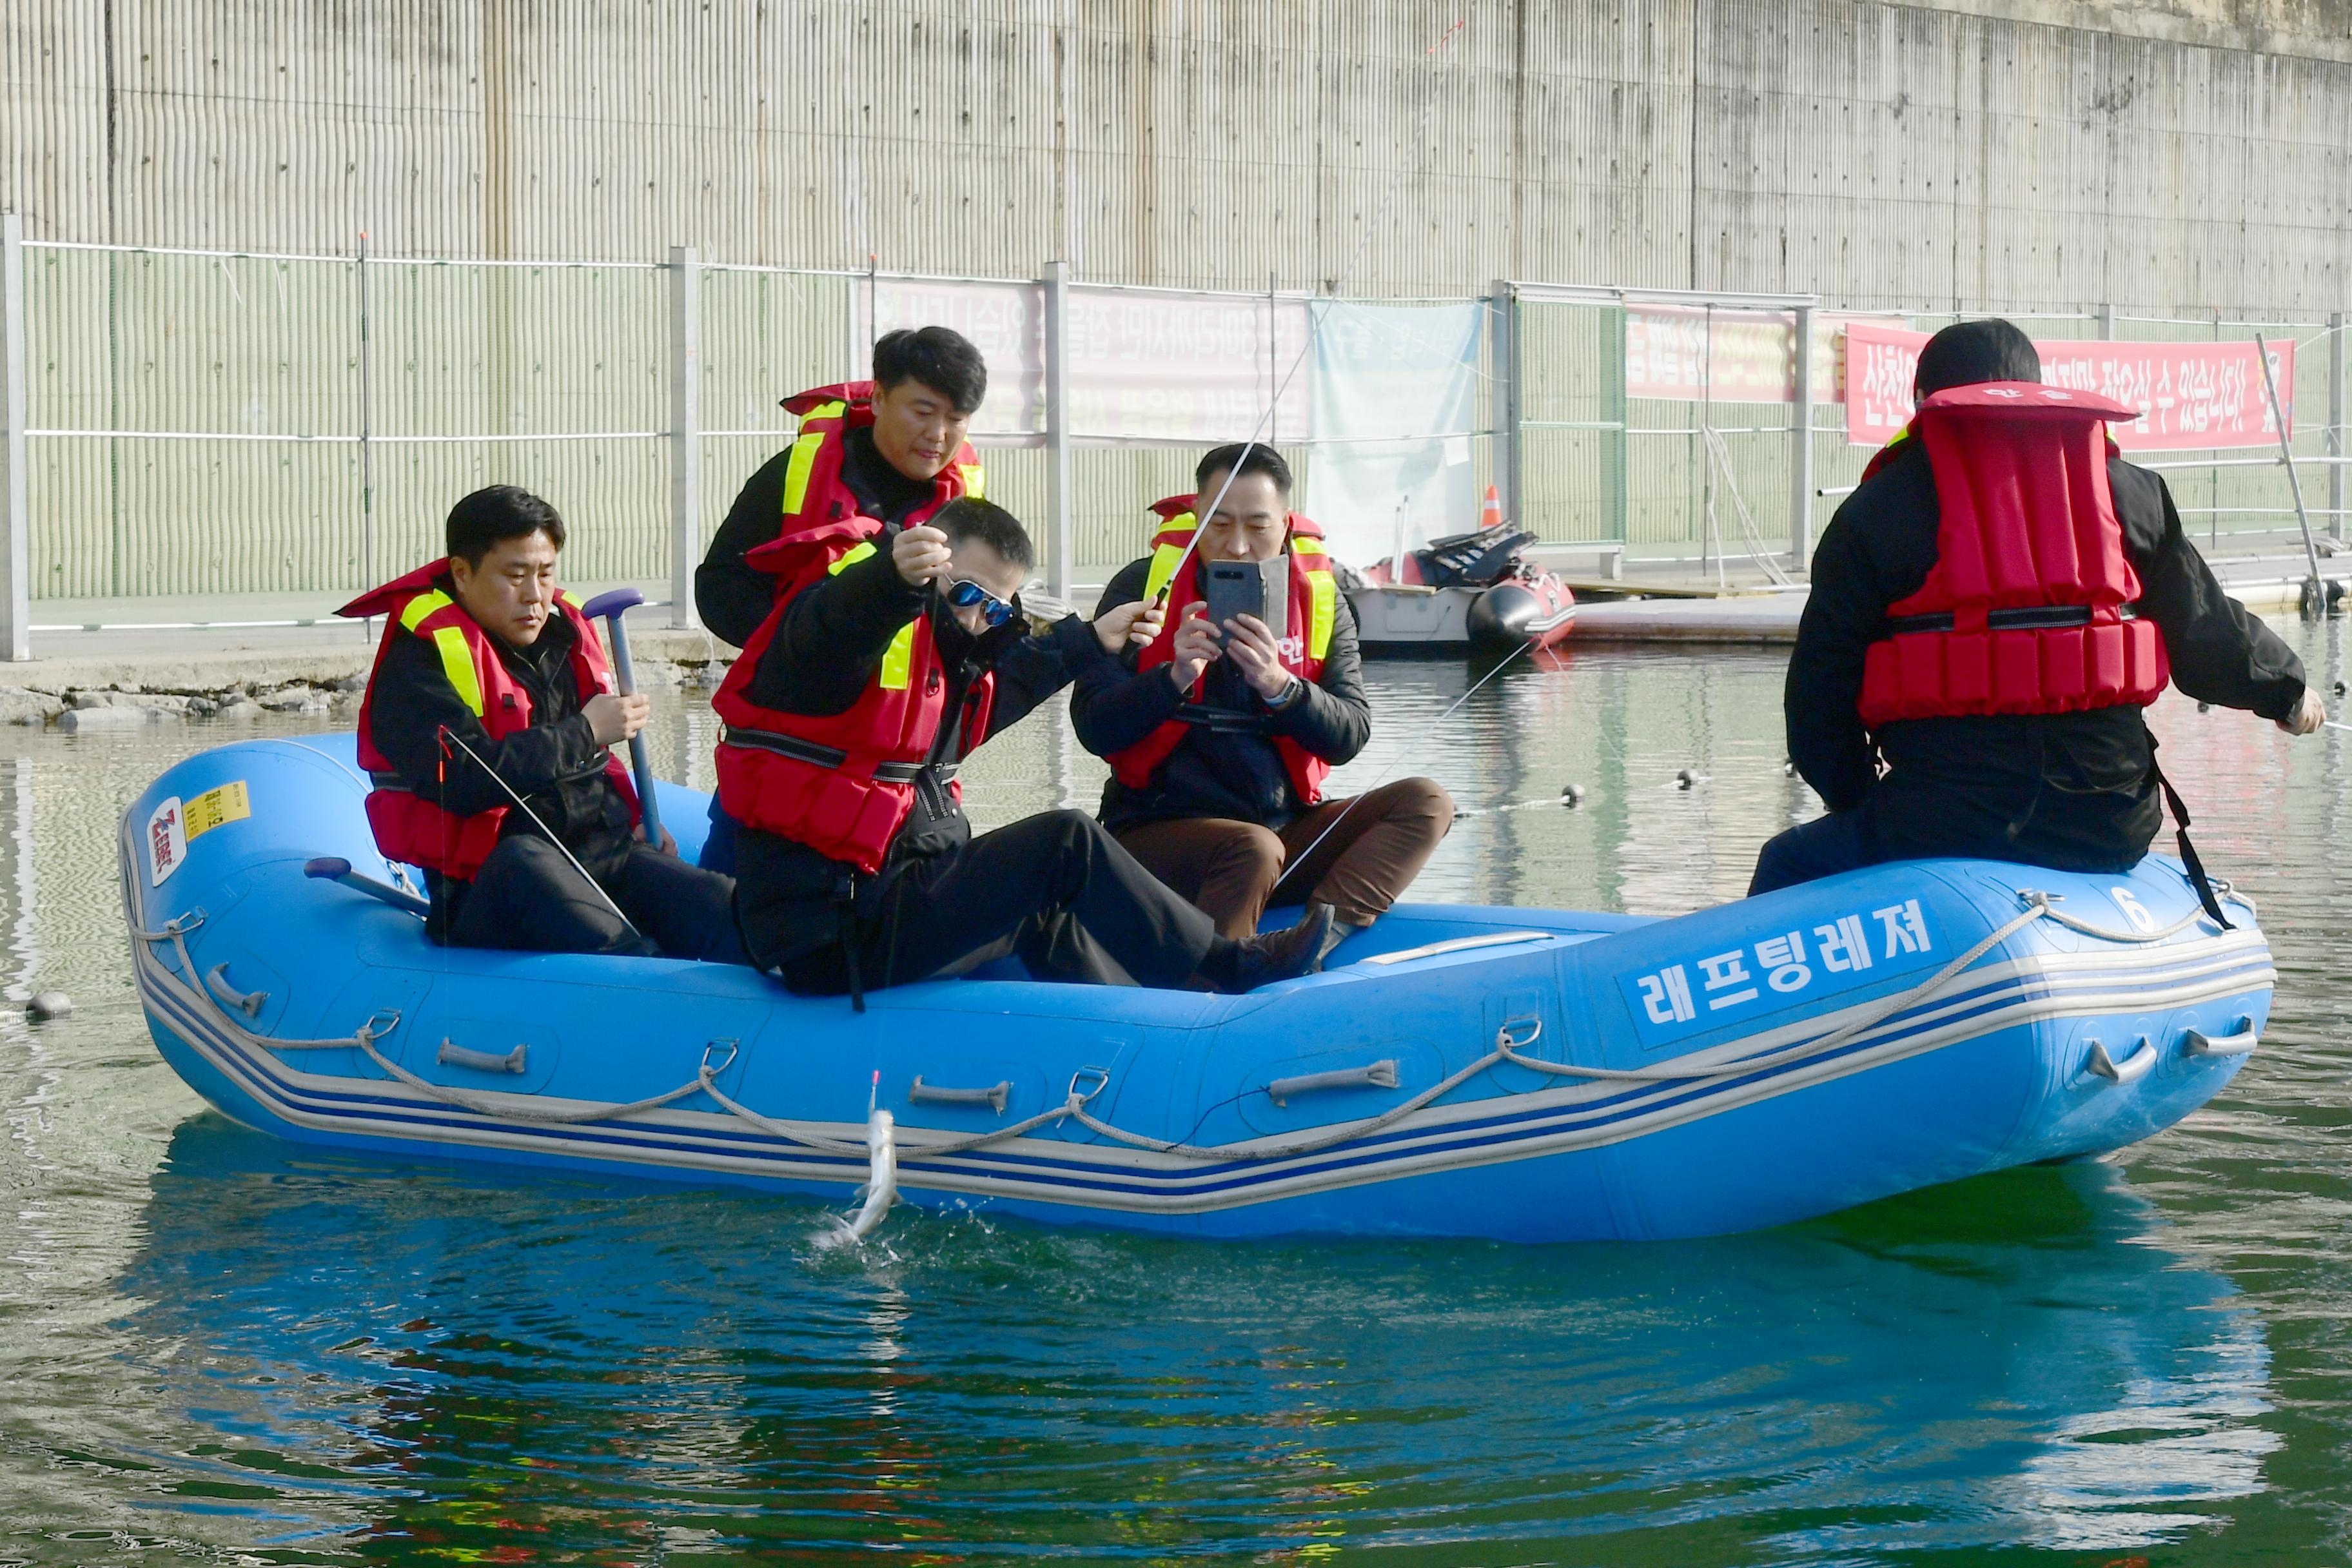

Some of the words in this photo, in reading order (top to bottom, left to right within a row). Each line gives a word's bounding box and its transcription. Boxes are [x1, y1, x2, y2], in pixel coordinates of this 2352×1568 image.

[2157, 358, 2175, 434] 수
[2111, 887, 2155, 934] 6
[1637, 899, 1932, 1024] 래프팅레져
